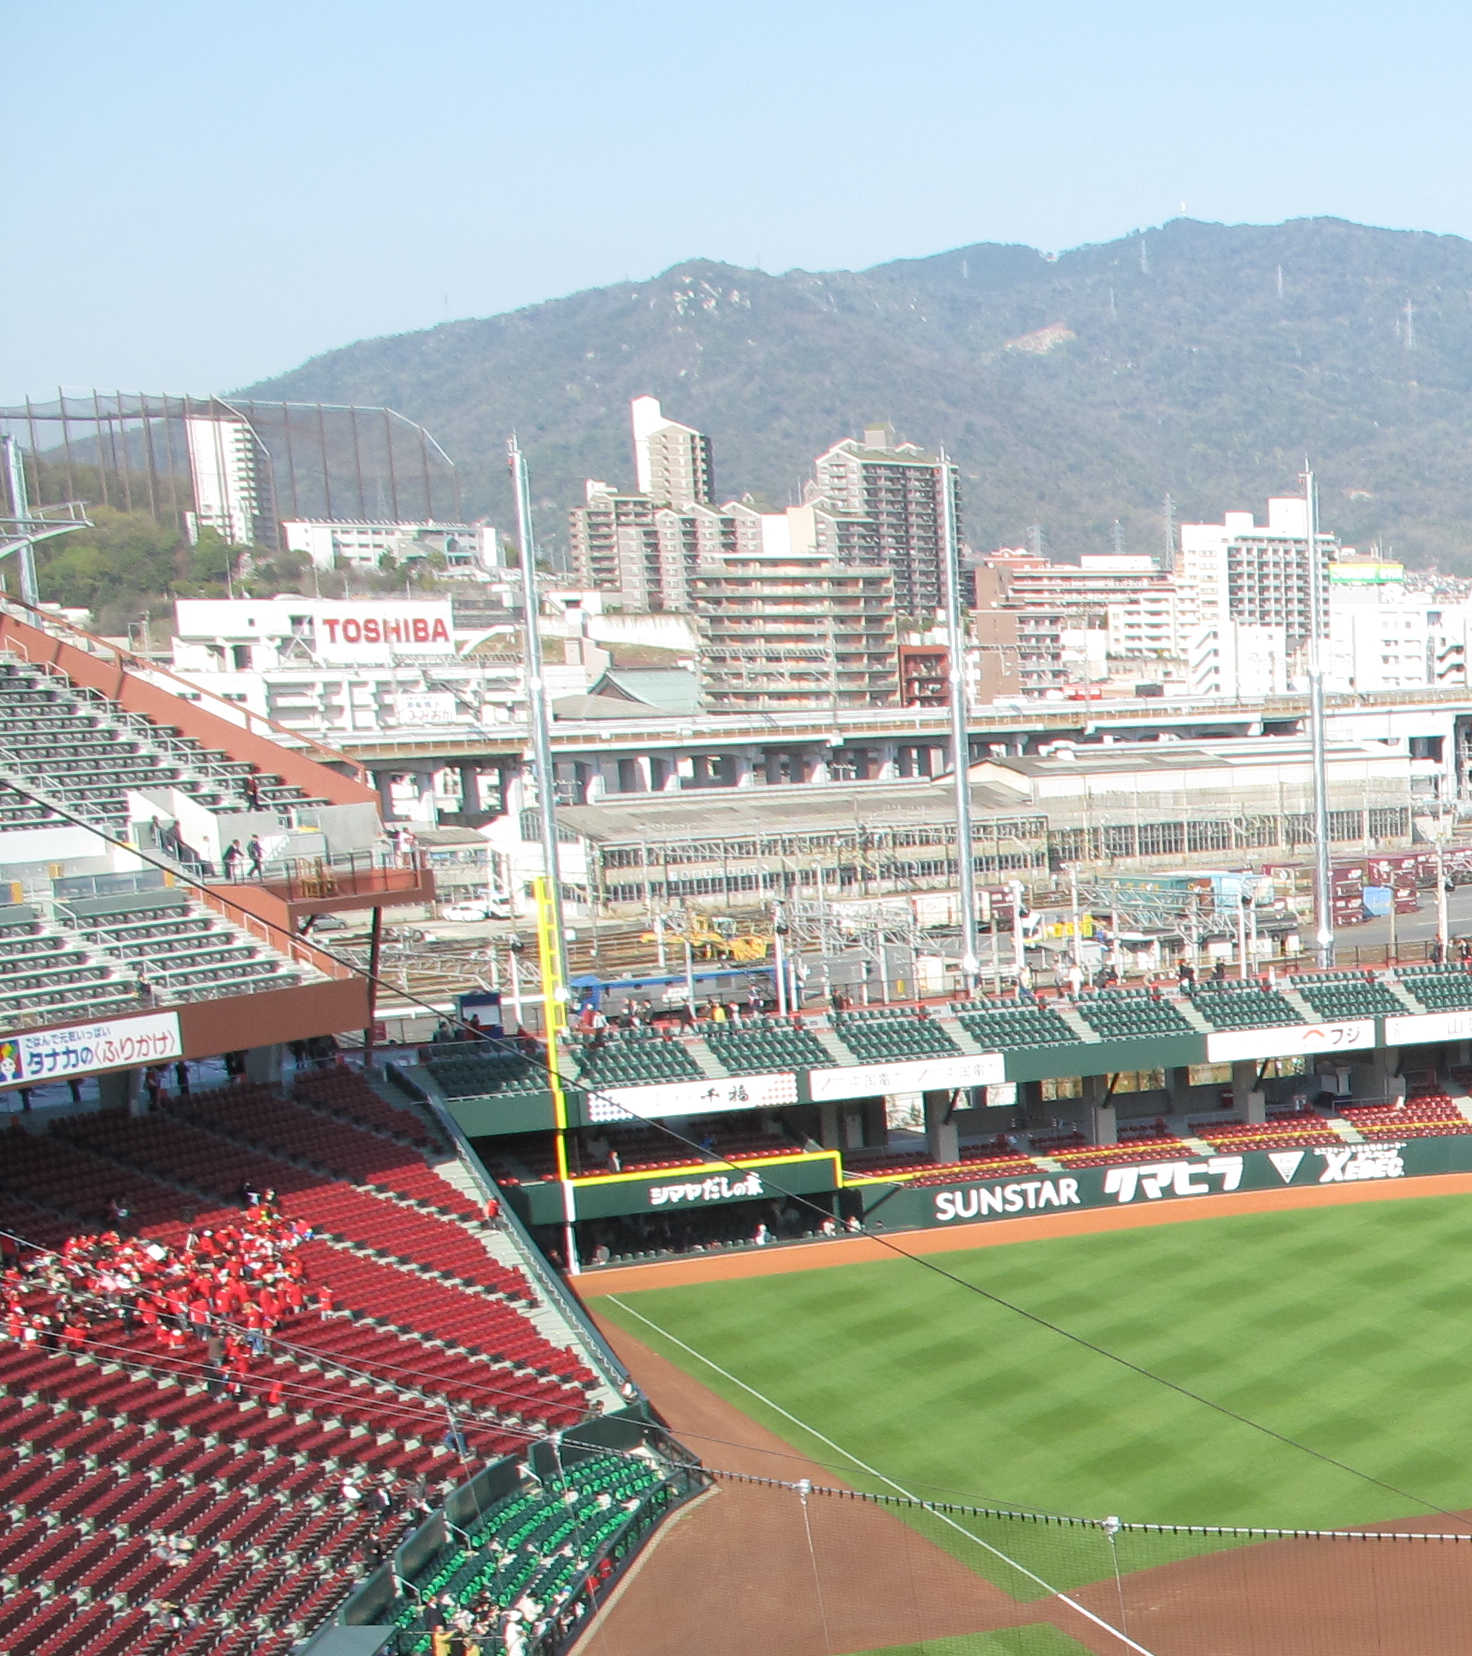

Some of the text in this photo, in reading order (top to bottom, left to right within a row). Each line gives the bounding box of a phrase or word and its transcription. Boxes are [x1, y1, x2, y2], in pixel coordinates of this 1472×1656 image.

[323, 618, 450, 644] TOSHIBA
[1330, 1026, 1361, 1045] フジ
[649, 1172, 764, 1206] シマヤだしの素
[1103, 1156, 1244, 1203] クマヒラ
[934, 1177, 1081, 1222] SUNSTAR
